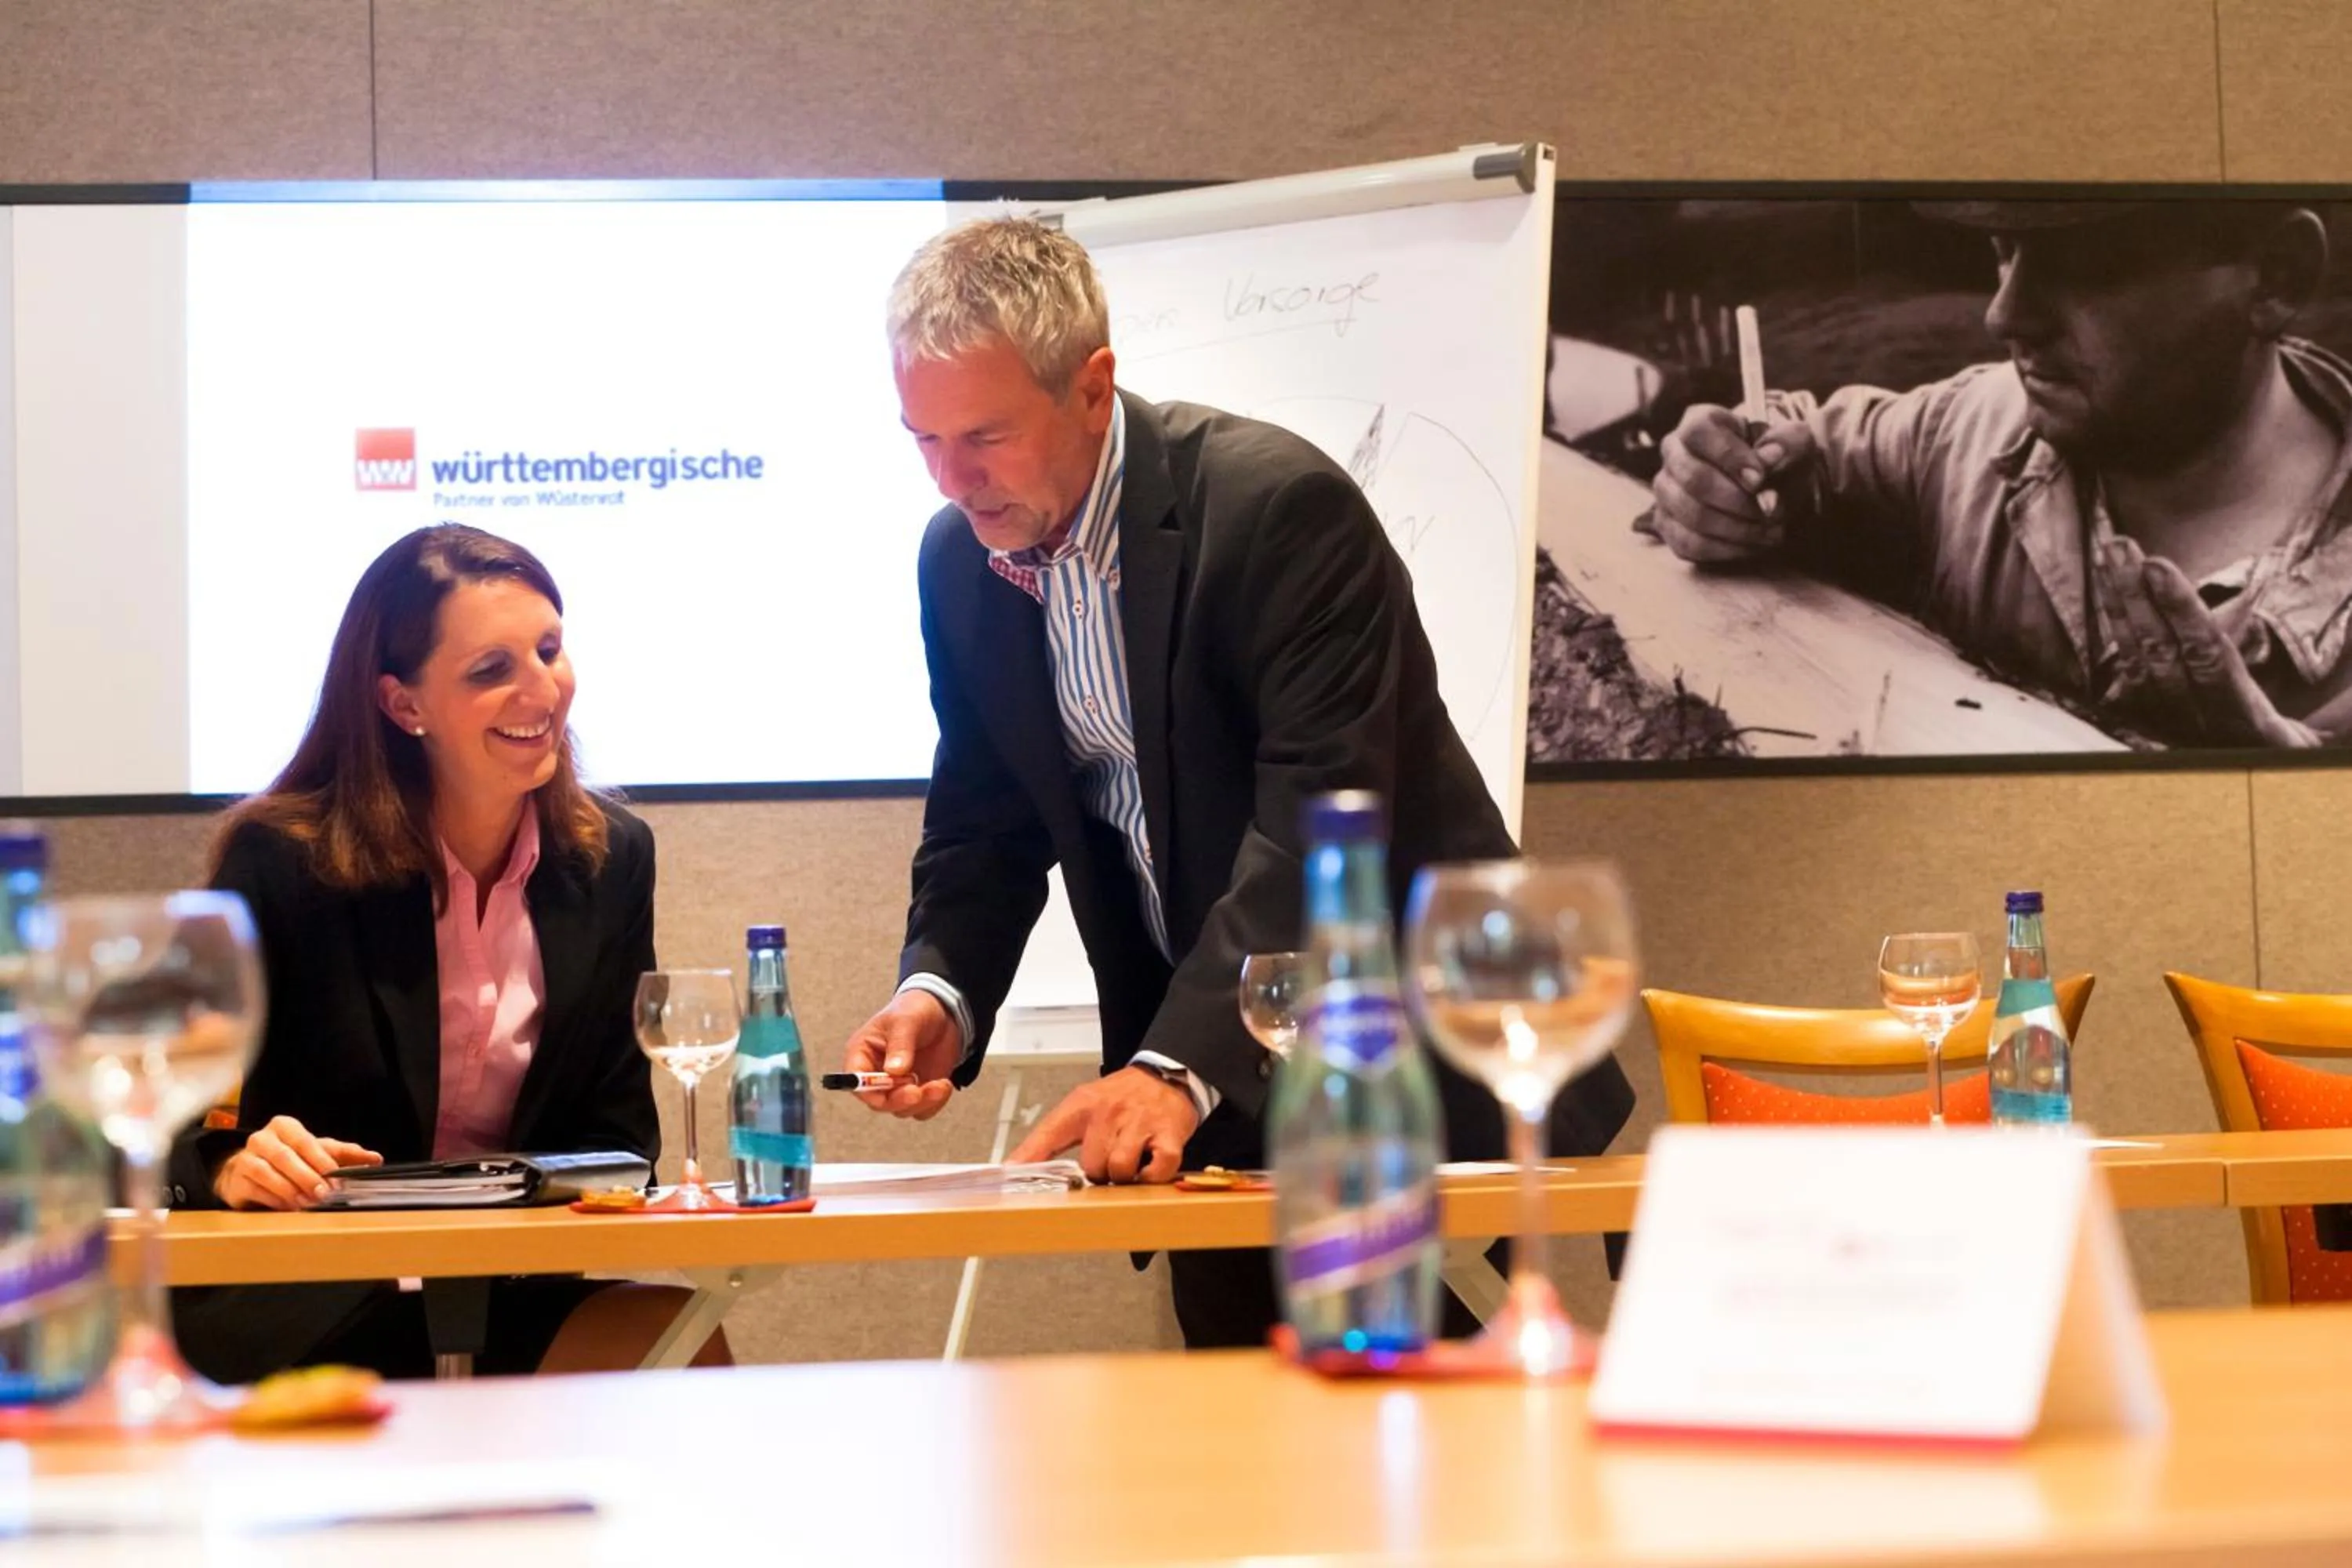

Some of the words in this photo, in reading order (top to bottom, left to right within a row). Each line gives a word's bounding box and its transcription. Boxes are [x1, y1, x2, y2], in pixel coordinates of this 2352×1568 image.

[1225, 271, 1381, 337] Vorsorge
[432, 449, 764, 488] württembergische
[434, 492, 494, 507] Partner
[501, 495, 530, 507] von
